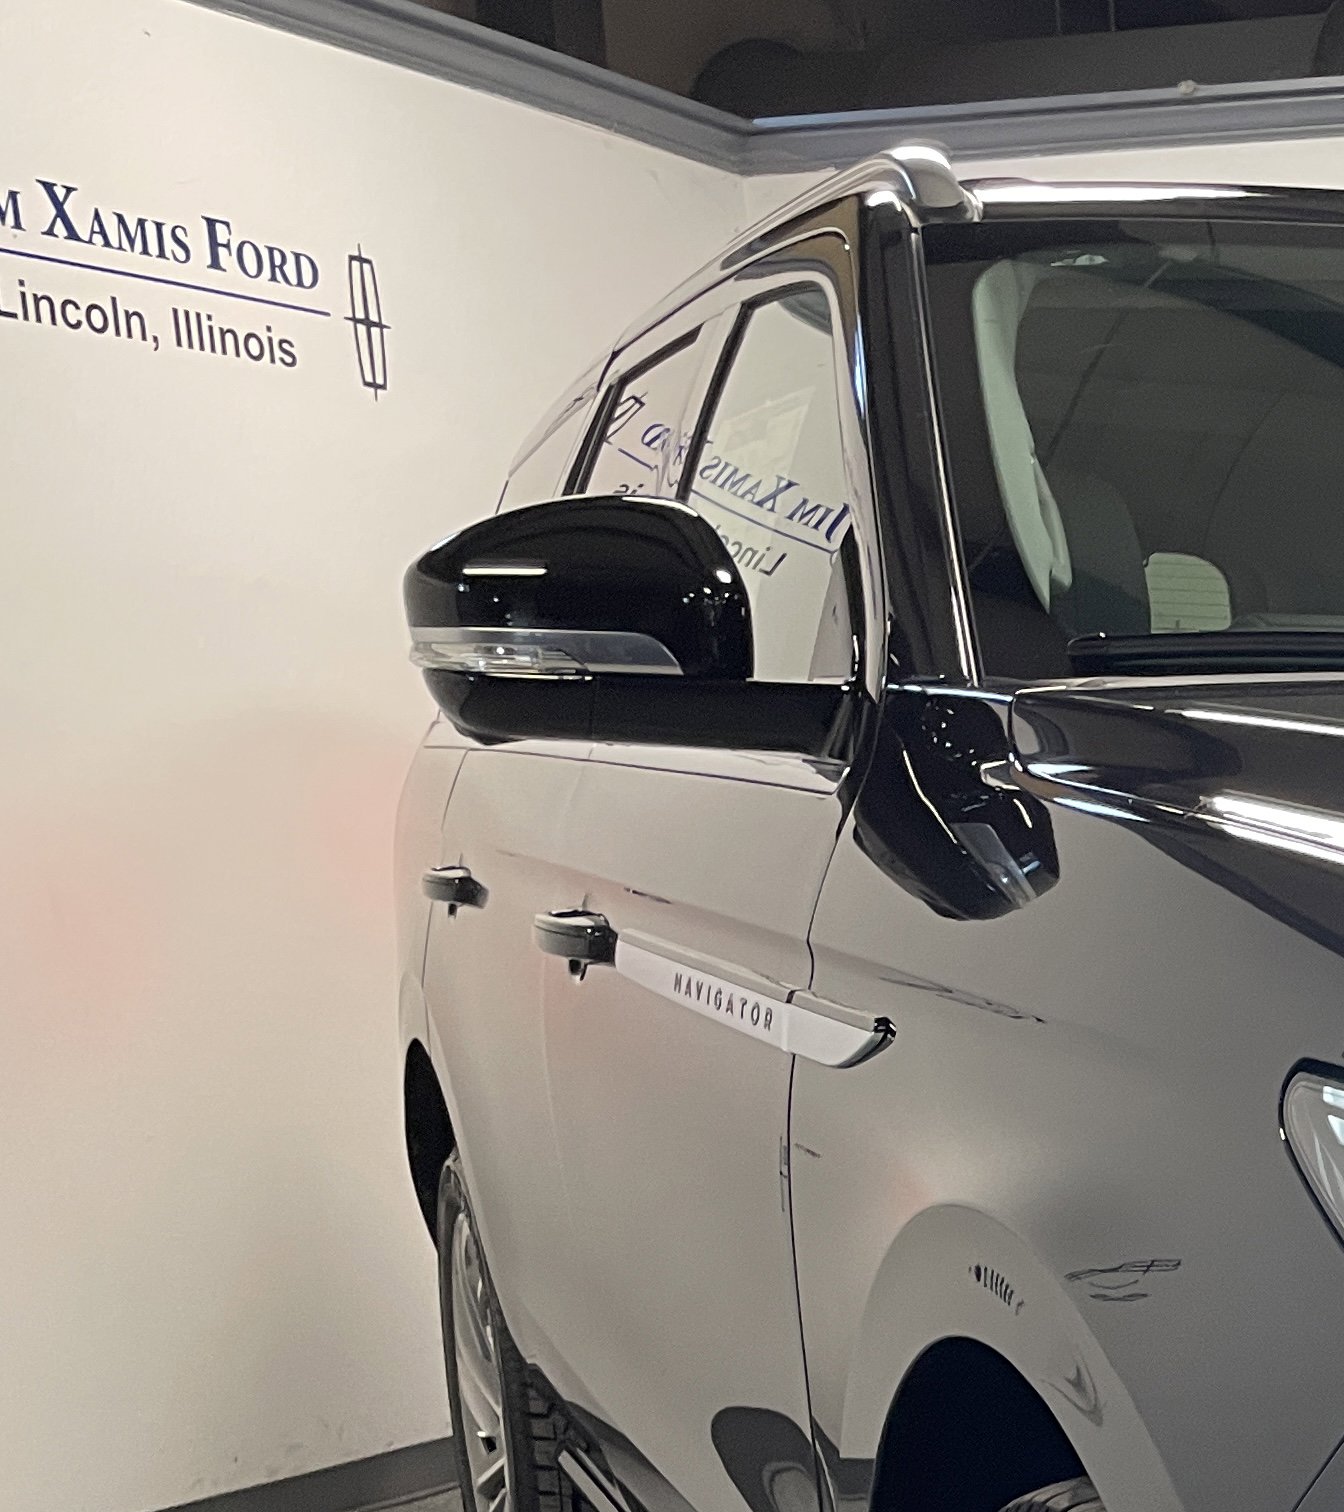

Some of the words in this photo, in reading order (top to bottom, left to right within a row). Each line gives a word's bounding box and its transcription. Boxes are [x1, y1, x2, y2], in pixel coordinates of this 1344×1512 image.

[36, 179, 192, 264] XAMIS
[201, 215, 320, 290] FORD
[172, 307, 298, 368] Illinois
[673, 972, 773, 1031] NAVIGATOR
